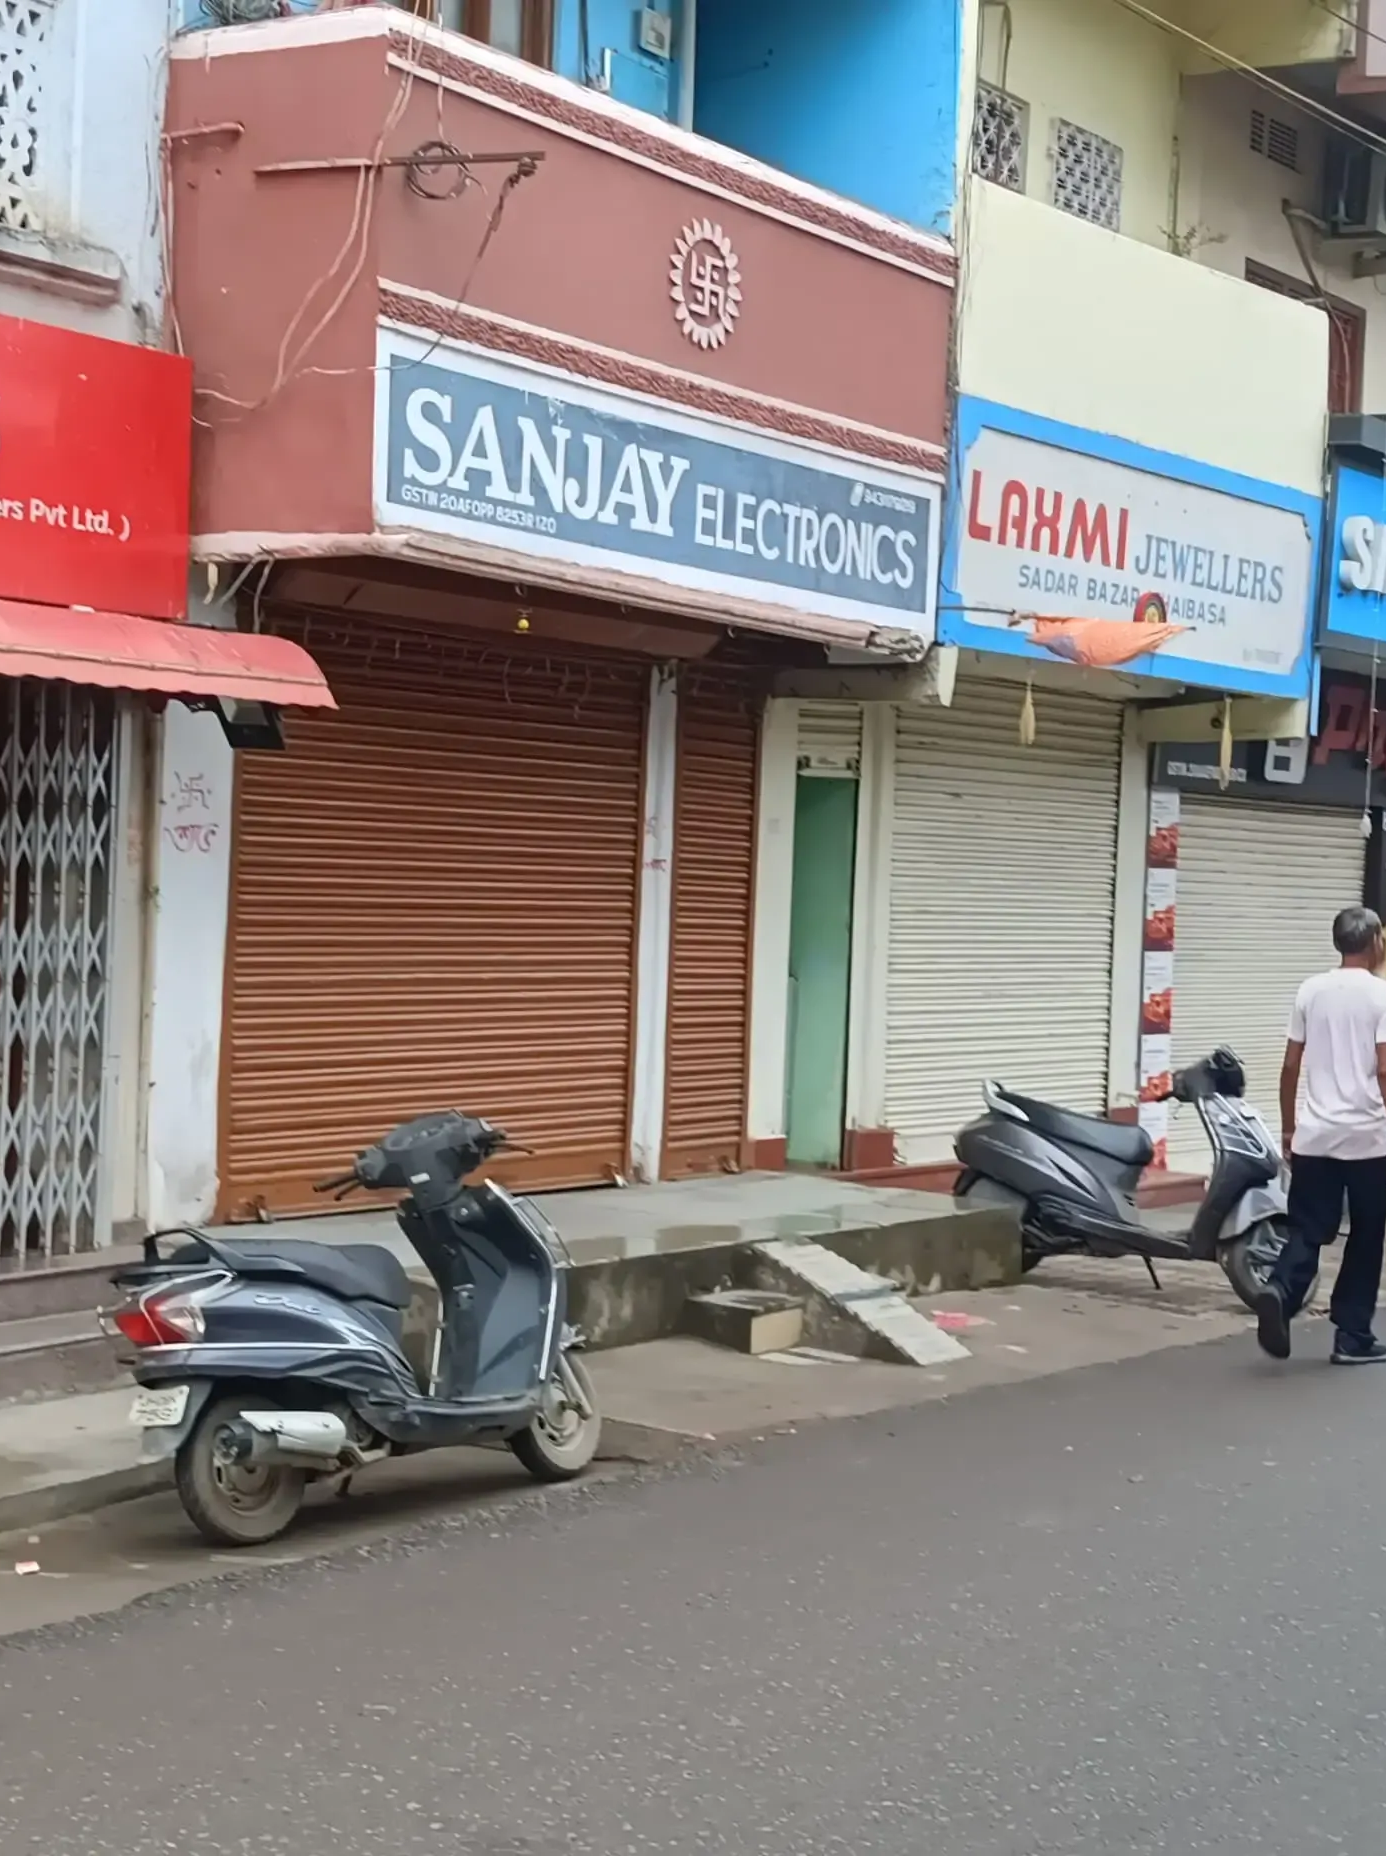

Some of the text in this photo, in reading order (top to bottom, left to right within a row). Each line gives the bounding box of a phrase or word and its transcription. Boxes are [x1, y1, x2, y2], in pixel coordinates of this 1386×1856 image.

[401, 484, 438, 507] GSTIN
[403, 387, 918, 590] SANJAY ELECTRONICS
[30, 498, 68, 529] Pvt
[968, 469, 1285, 605] LAXMI JEWELLERS
[1018, 564, 1079, 598] SADAR
